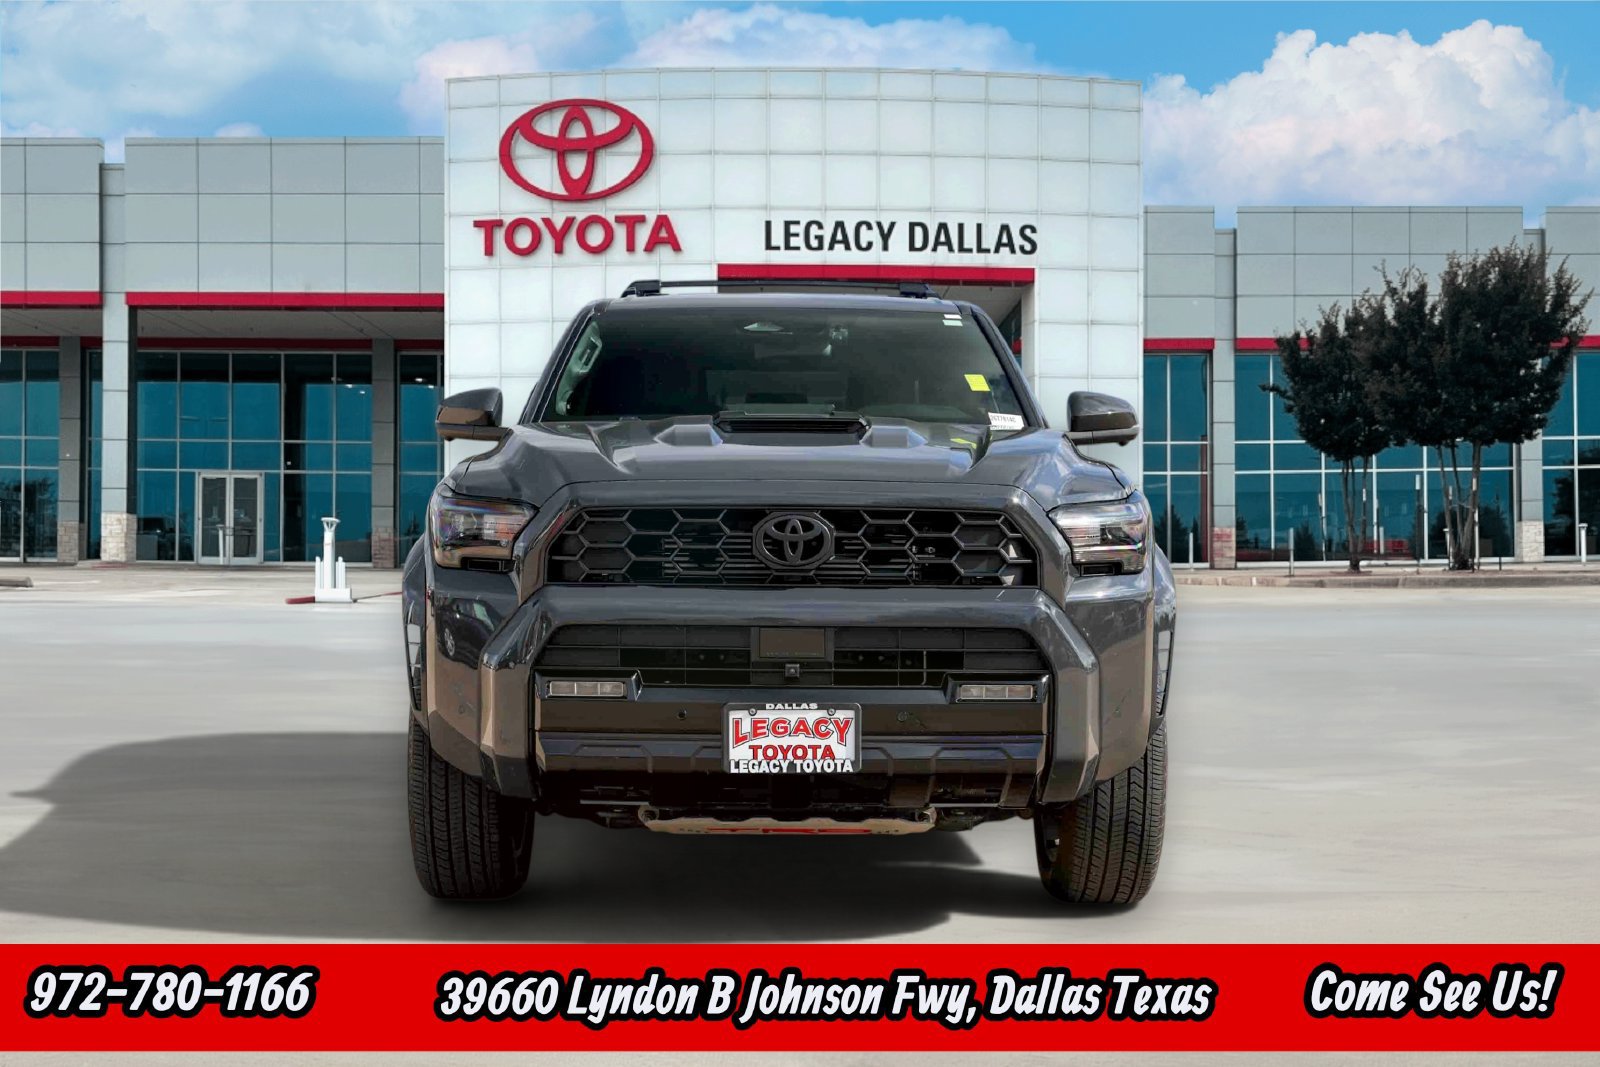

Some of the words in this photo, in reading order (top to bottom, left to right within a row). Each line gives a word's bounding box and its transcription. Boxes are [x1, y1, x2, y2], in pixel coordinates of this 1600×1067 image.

[474, 214, 682, 257] TOYOTA
[765, 220, 896, 252] LEGACY
[908, 221, 1038, 255] DALLAS
[765, 702, 818, 710] DALLAS
[732, 717, 853, 749] LEGACY
[748, 744, 836, 761] TOYOTA
[730, 759, 790, 774] LEGACY
[794, 759, 854, 774] TOYOTA
